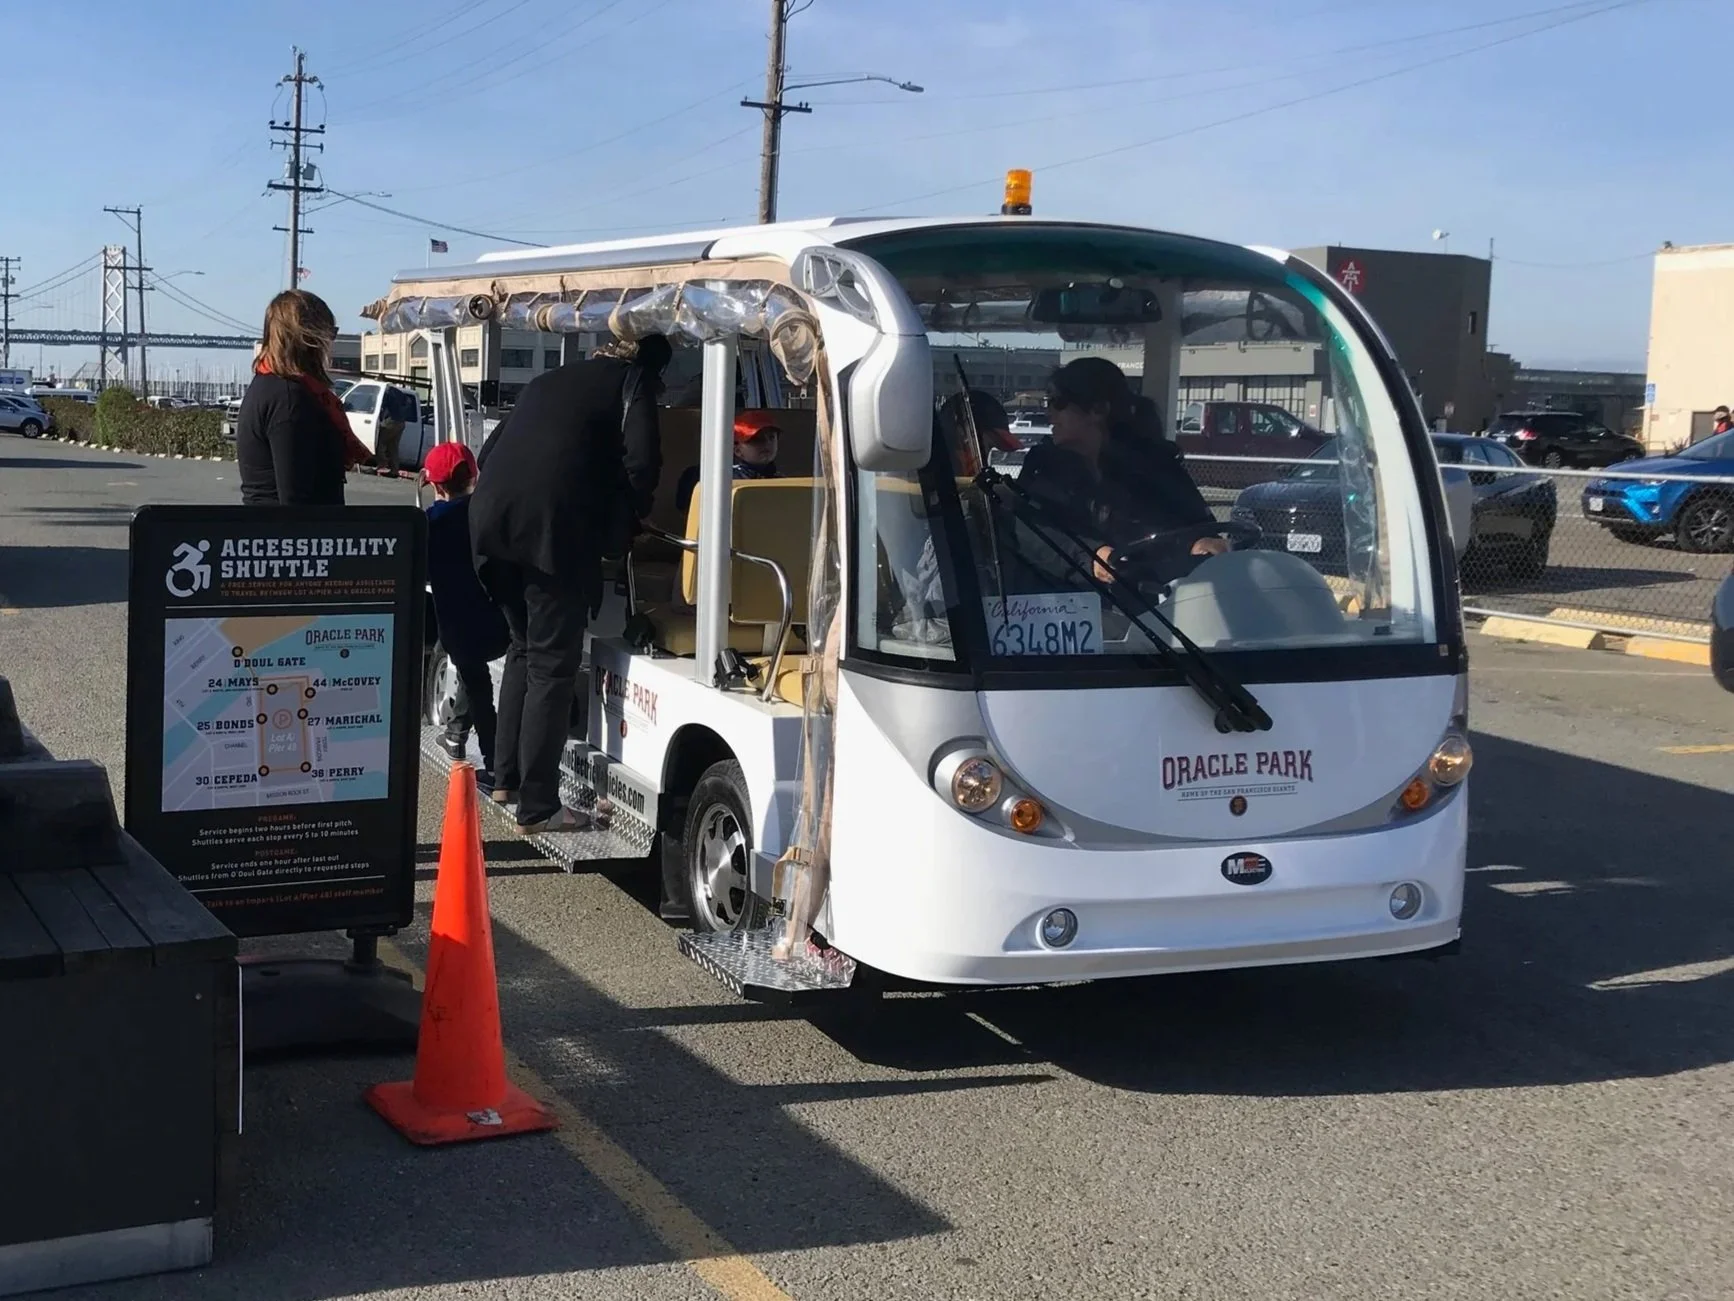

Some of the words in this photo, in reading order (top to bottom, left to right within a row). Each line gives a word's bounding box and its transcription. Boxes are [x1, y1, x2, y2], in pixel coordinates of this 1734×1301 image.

[220, 538, 397, 557] ACCESSIBILITY
[221, 559, 329, 578] SHUTTLE
[306, 629, 352, 646] ORACLE
[354, 628, 385, 644] PARK
[992, 620, 1096, 656] 6348M2
[278, 656, 306, 667] GATE
[208, 678, 222, 688] 24
[227, 677, 260, 687] MAYS
[313, 678, 327, 688] 44
[633, 682, 658, 726] PARK
[197, 721, 210, 731] 25
[216, 719, 254, 730] BONDS
[307, 717, 321, 726] 27
[325, 714, 382, 726] MARICHAL
[329, 766, 364, 777] PERRY
[1162, 752, 1248, 791] ORACLE
[1256, 750, 1314, 783] PARK
[196, 776, 210, 786] 30
[214, 774, 258, 785] CEPEDA
[1237, 786, 1272, 794] FRANCISCO
[199, 828, 227, 836] Service
[228, 826, 253, 835] begins
[334, 820, 352, 828] pitch
[191, 838, 223, 846] Shuttles
[330, 829, 359, 837] minutes
[211, 862, 238, 870] Service
[275, 866, 303, 875] directly
[313, 863, 349, 872] requested
